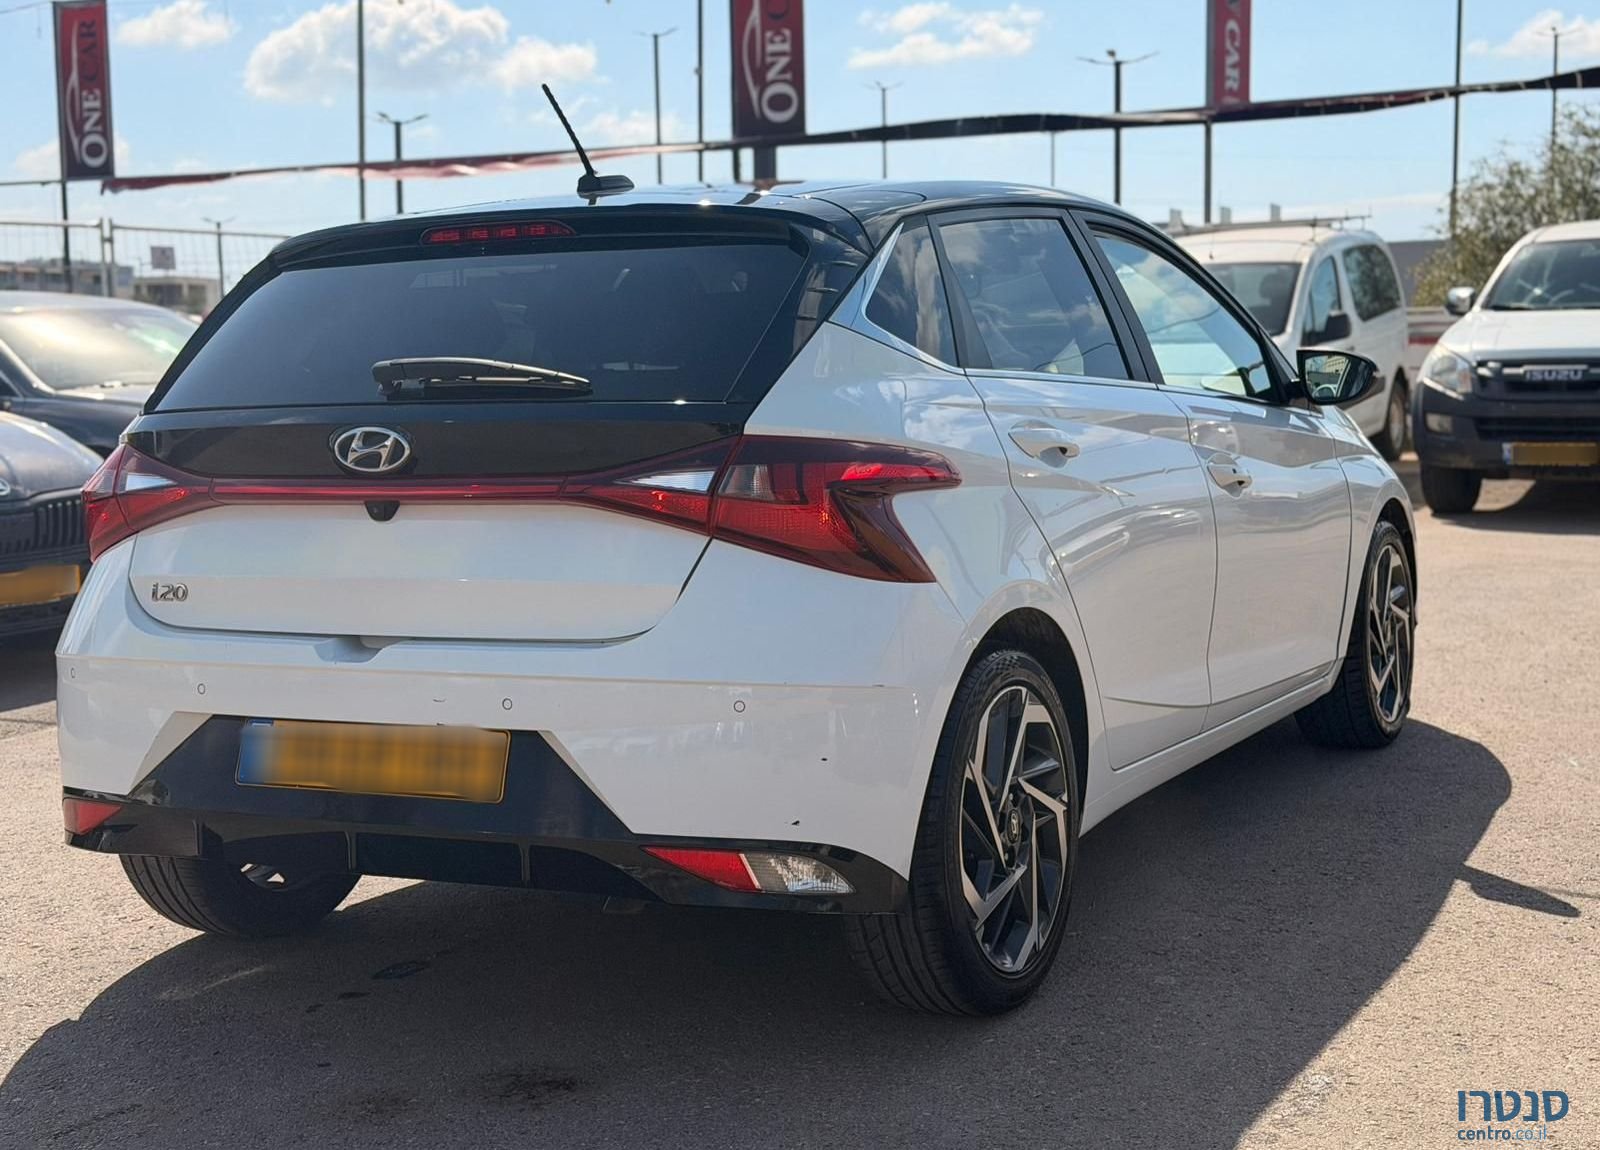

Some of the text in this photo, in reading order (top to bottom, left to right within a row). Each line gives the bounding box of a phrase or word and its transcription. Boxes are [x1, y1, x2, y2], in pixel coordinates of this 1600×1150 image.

[761, 27, 799, 123] ONE
[1225, 19, 1241, 92] CAR
[80, 19, 108, 168] ONE CAR
[1525, 369, 1584, 380] ISUZU
[151, 582, 189, 602] i20
